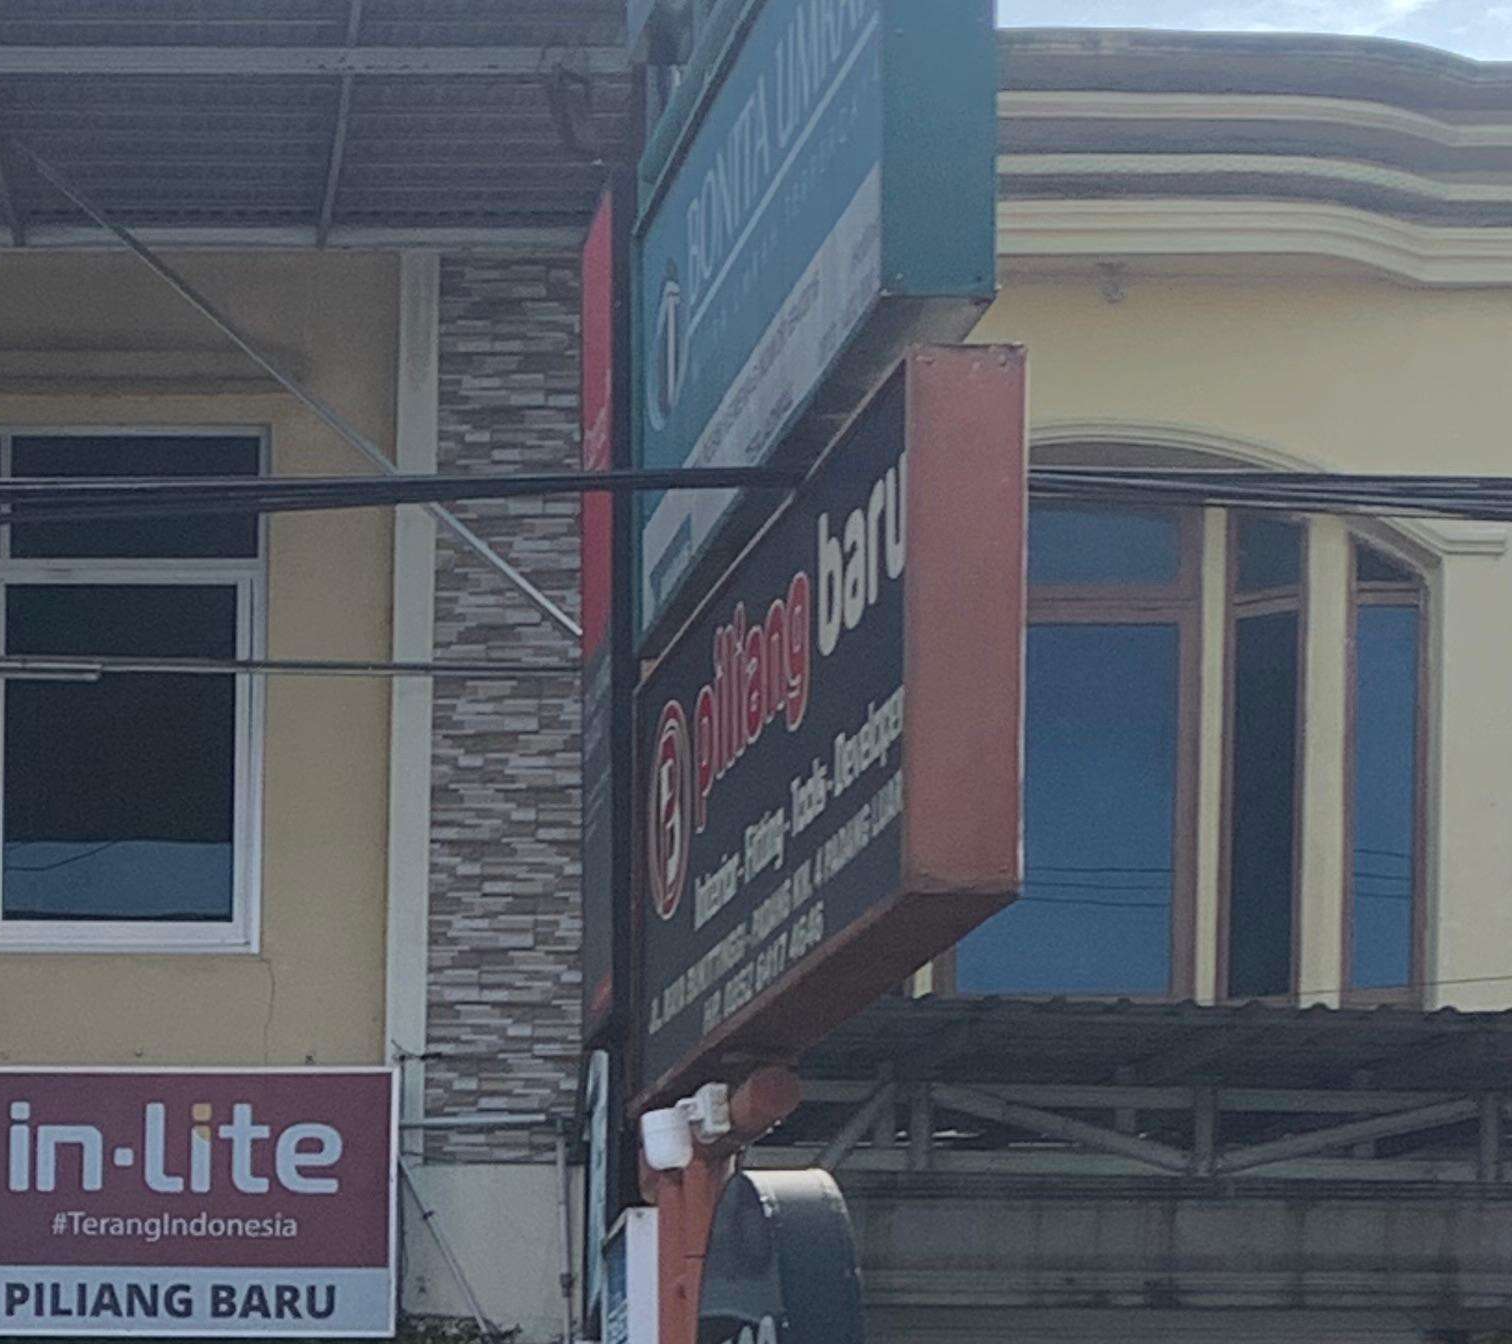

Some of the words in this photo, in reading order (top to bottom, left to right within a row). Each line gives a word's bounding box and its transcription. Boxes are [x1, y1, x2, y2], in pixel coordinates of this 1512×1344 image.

[694, 571, 810, 834] piliang
[817, 451, 906, 656] baru
[834, 684, 905, 797] Develope
[52, 1211, 299, 1243] #TerangIndonesia
[4, 1281, 194, 1319] PILIANG
[210, 1283, 337, 1320] BARU
